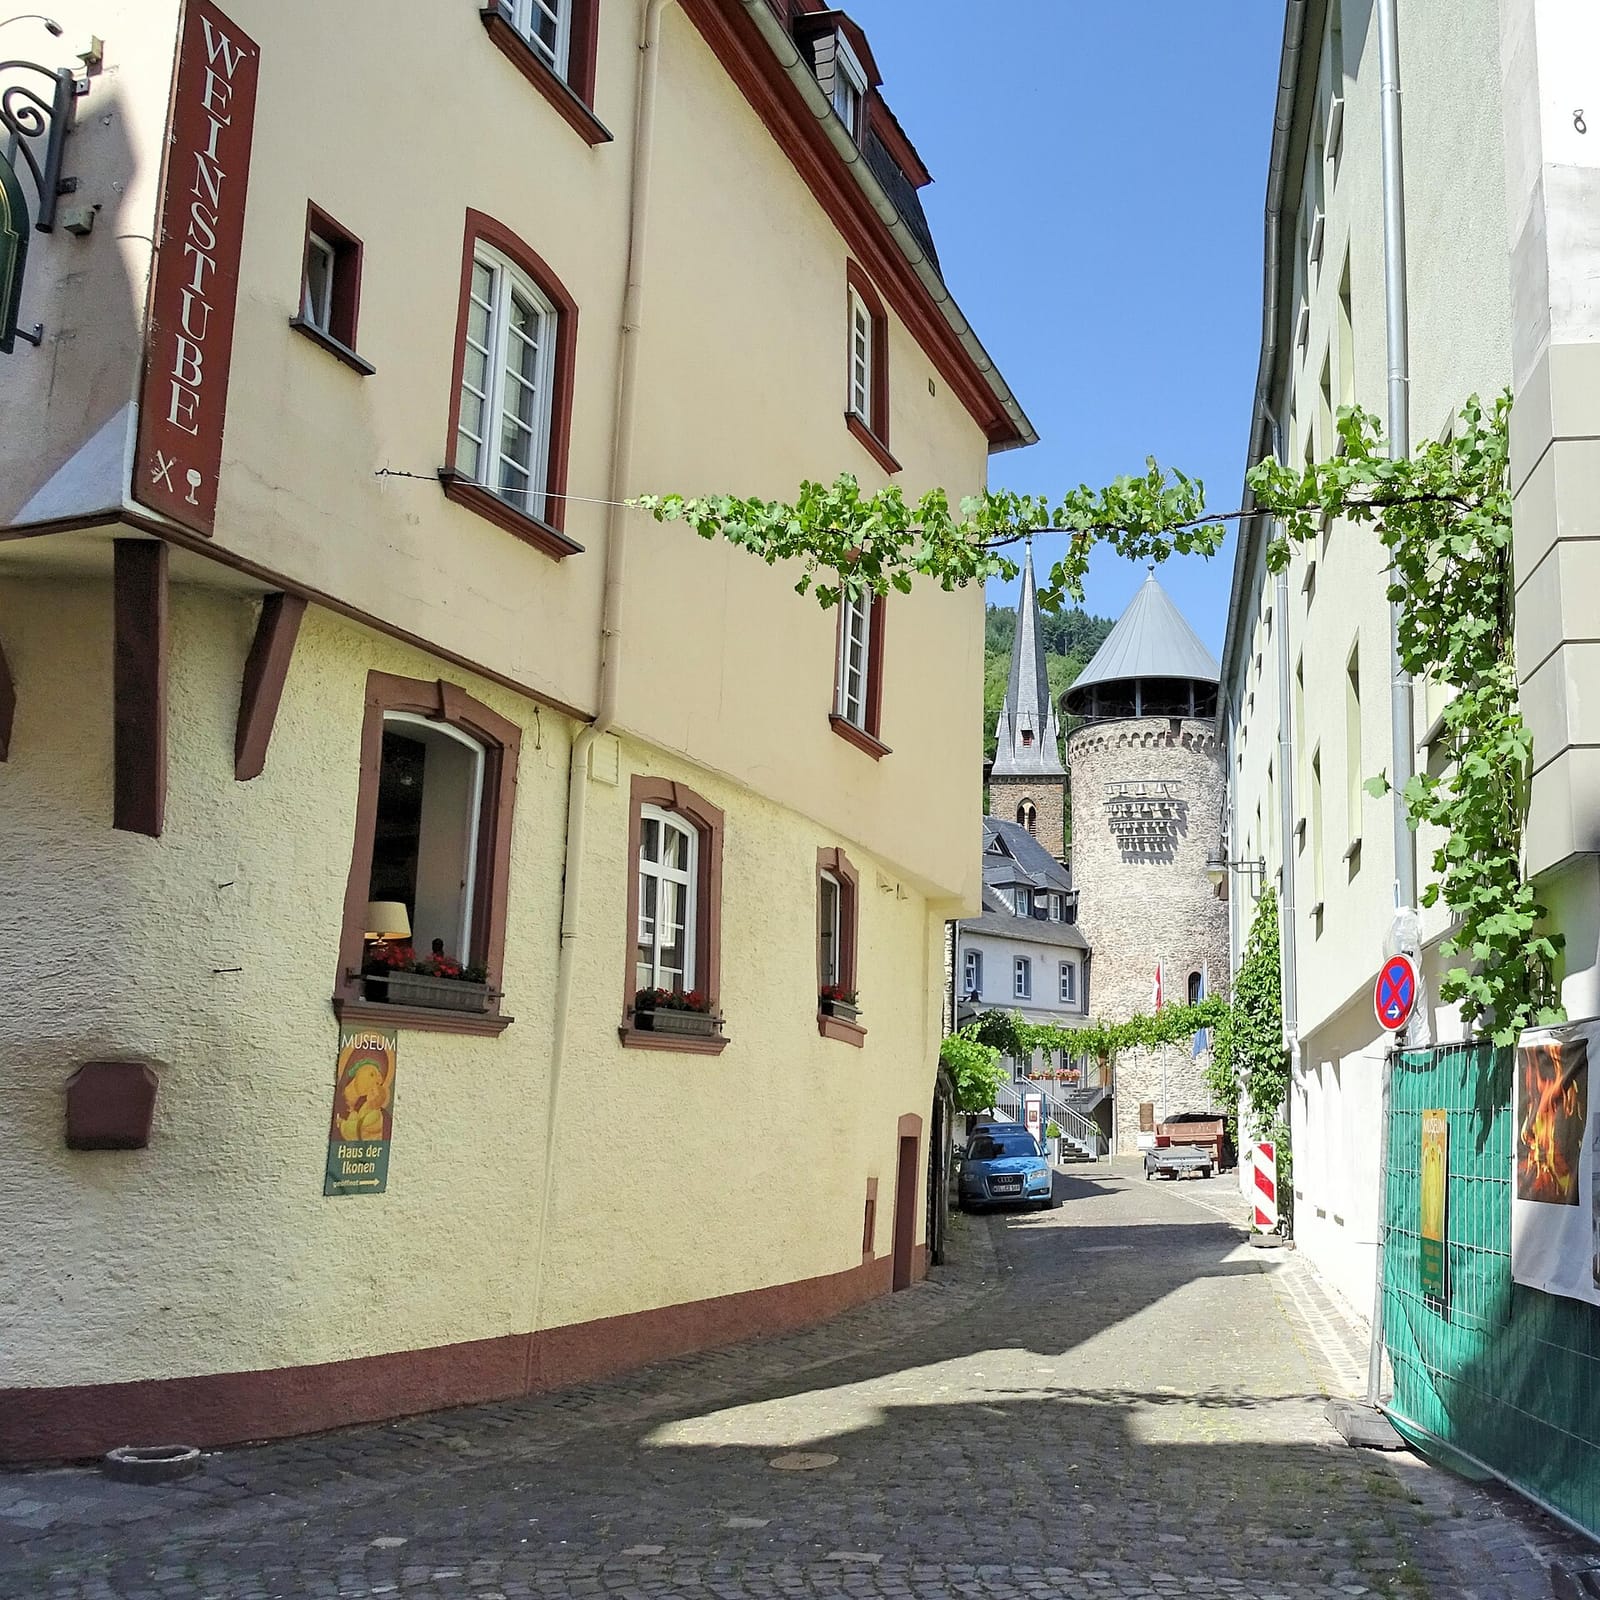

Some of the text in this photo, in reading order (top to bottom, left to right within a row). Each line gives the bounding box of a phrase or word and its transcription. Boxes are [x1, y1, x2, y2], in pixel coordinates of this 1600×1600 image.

[166, 14, 247, 436] WEINSTUBE
[341, 1033, 396, 1051] MUSEUM
[338, 1145, 383, 1159] Haus der
[342, 1161, 375, 1174] Ikonen
